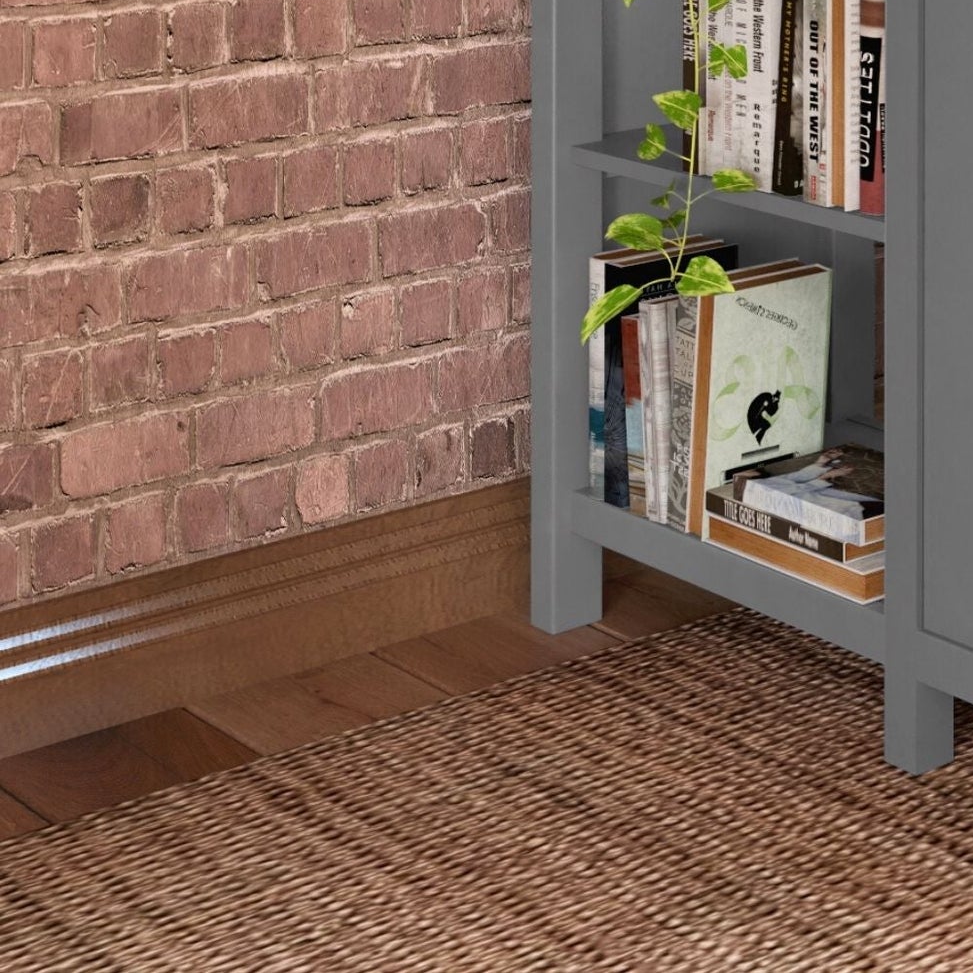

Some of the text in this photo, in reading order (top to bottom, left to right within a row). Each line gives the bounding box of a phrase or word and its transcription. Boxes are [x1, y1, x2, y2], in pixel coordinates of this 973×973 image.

[752, 0, 764, 12] the
[752, 15, 764, 49] Western
[752, 51, 764, 73] Front
[809, 20, 819, 163] OUT OF THE WEST
[753, 103, 762, 173] Remarque
[723, 499, 772, 534] TITLE GOES HERE
